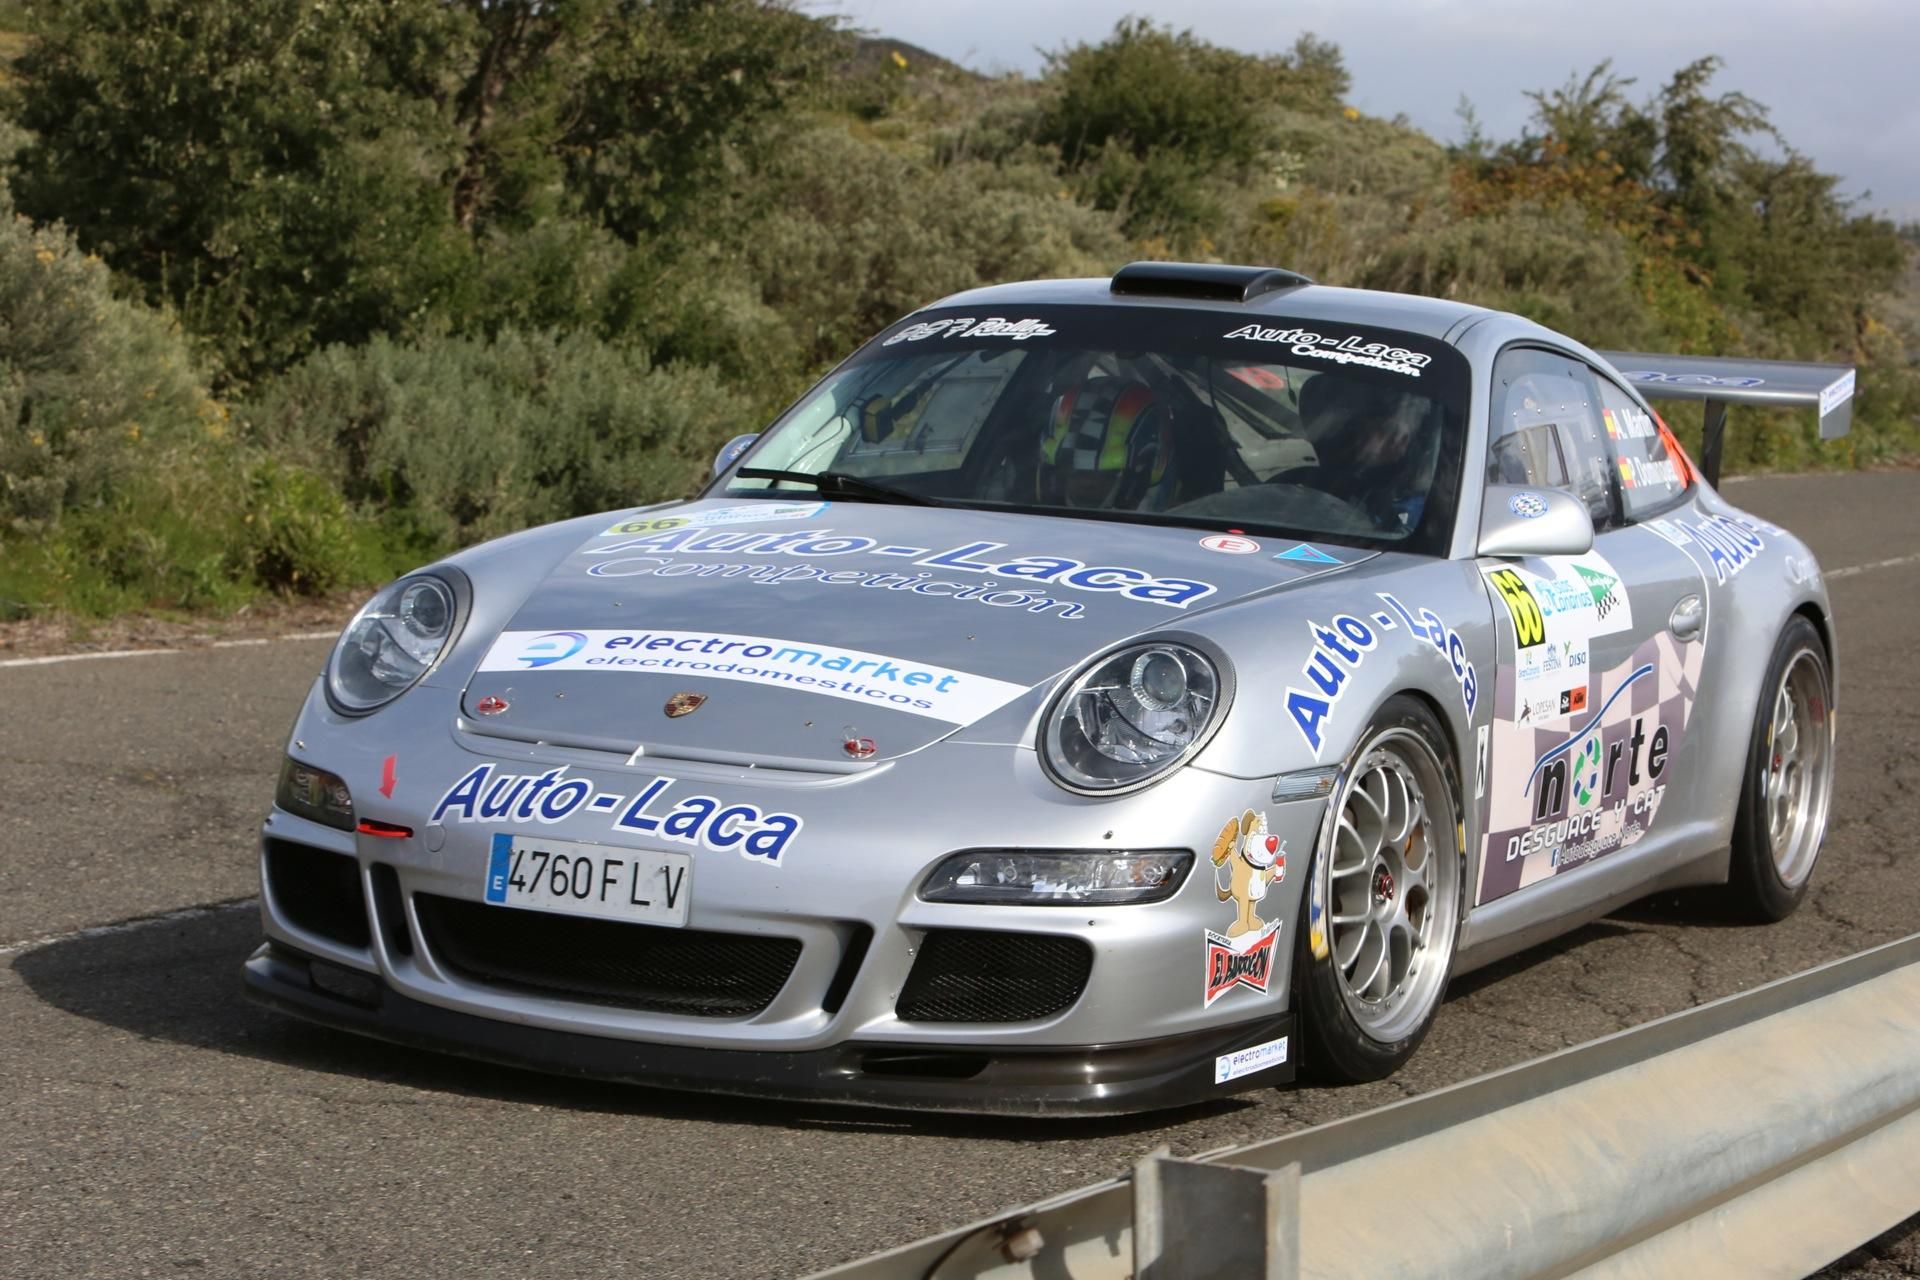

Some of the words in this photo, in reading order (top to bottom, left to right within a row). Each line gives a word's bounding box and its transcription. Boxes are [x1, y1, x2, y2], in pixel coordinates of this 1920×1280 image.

[1223, 324, 1433, 367] Auto-Laca
[619, 517, 680, 534] 66
[1217, 539, 1245, 551] E
[581, 525, 1217, 609] Auto-Laca
[586, 557, 1085, 620] Competición
[1490, 569, 1543, 646] 66
[585, 655, 933, 710] electrodomesticos
[603, 633, 959, 694] electromarket
[427, 763, 803, 868] Auto-Laca
[1505, 806, 1603, 862] DESGUACE
[1614, 798, 1625, 823] Y
[1633, 784, 1667, 815] CAT
